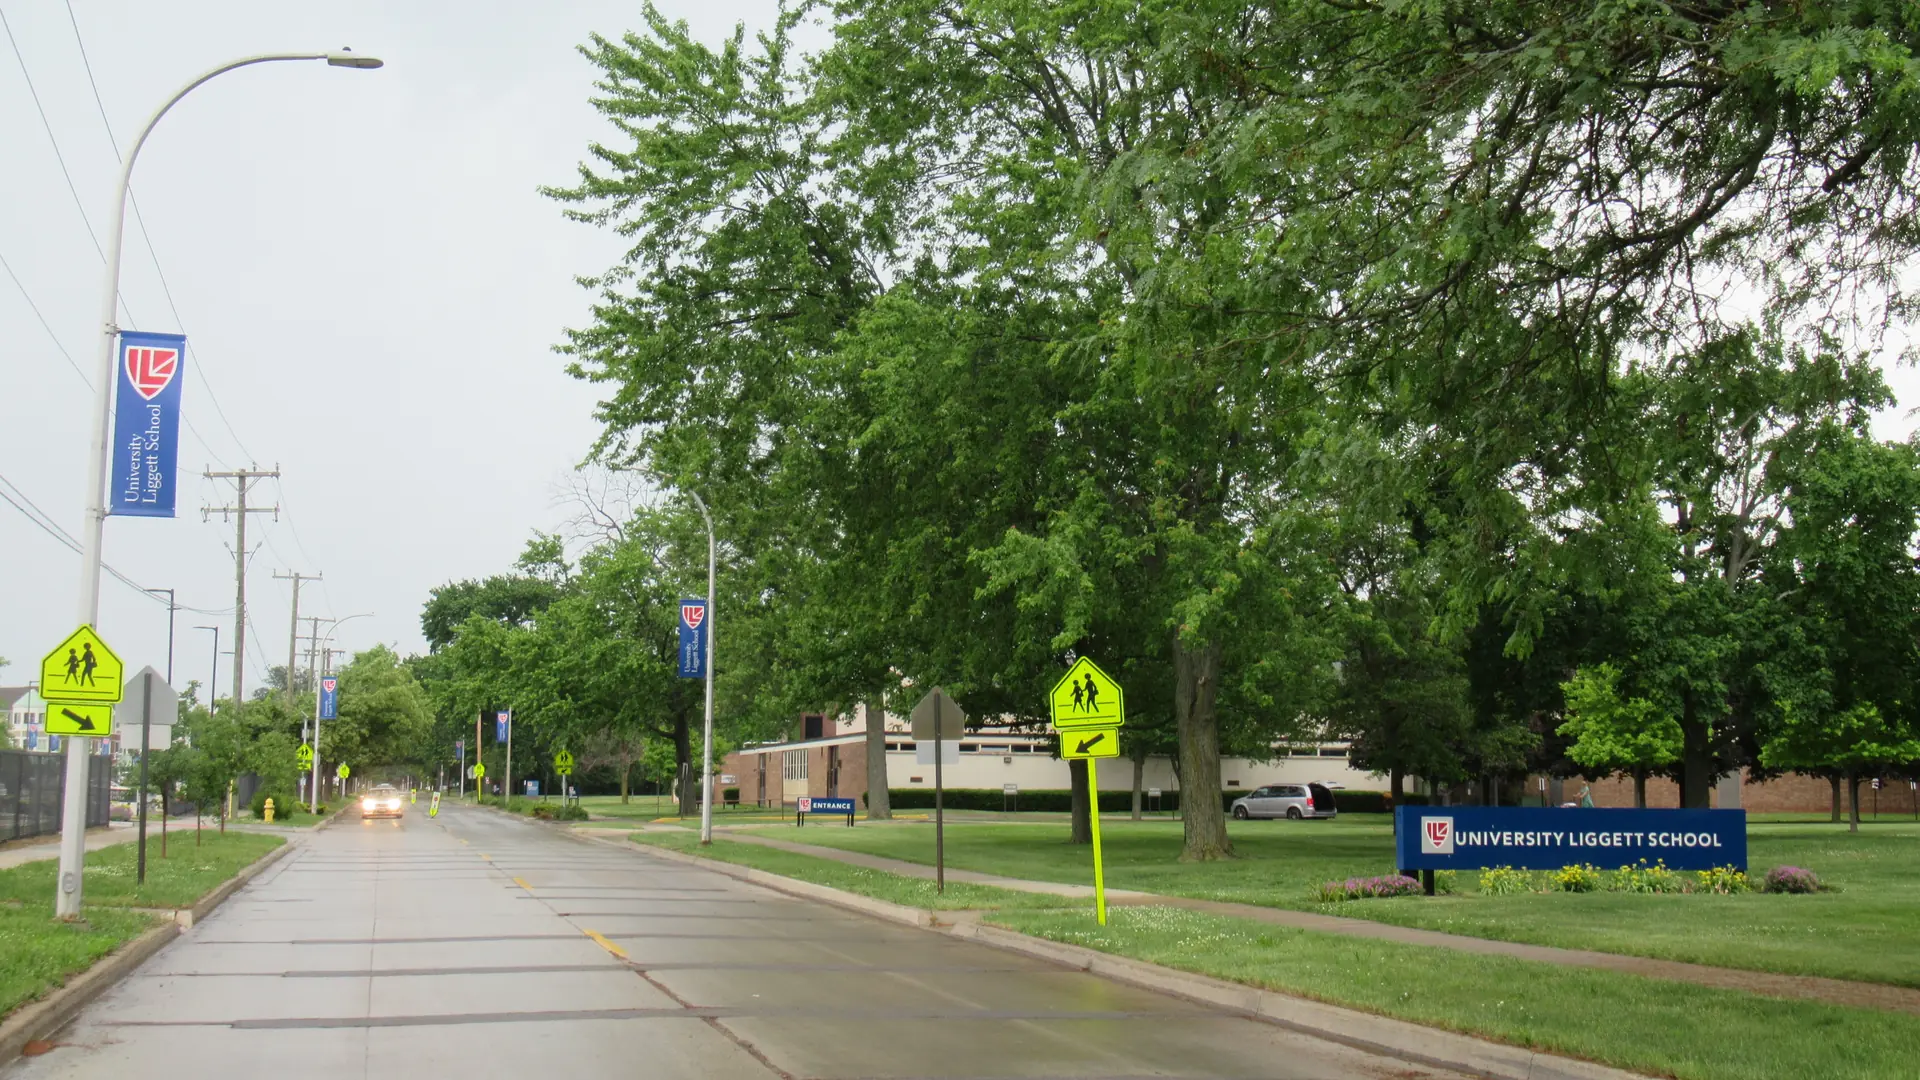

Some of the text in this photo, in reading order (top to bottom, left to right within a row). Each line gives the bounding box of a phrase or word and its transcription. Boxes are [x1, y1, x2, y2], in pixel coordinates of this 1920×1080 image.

[124, 433, 146, 502] University
[142, 404, 162, 504] Liggett School
[1455, 831, 1722, 848] UNIVERSITY LIGGETT SCHOOL
